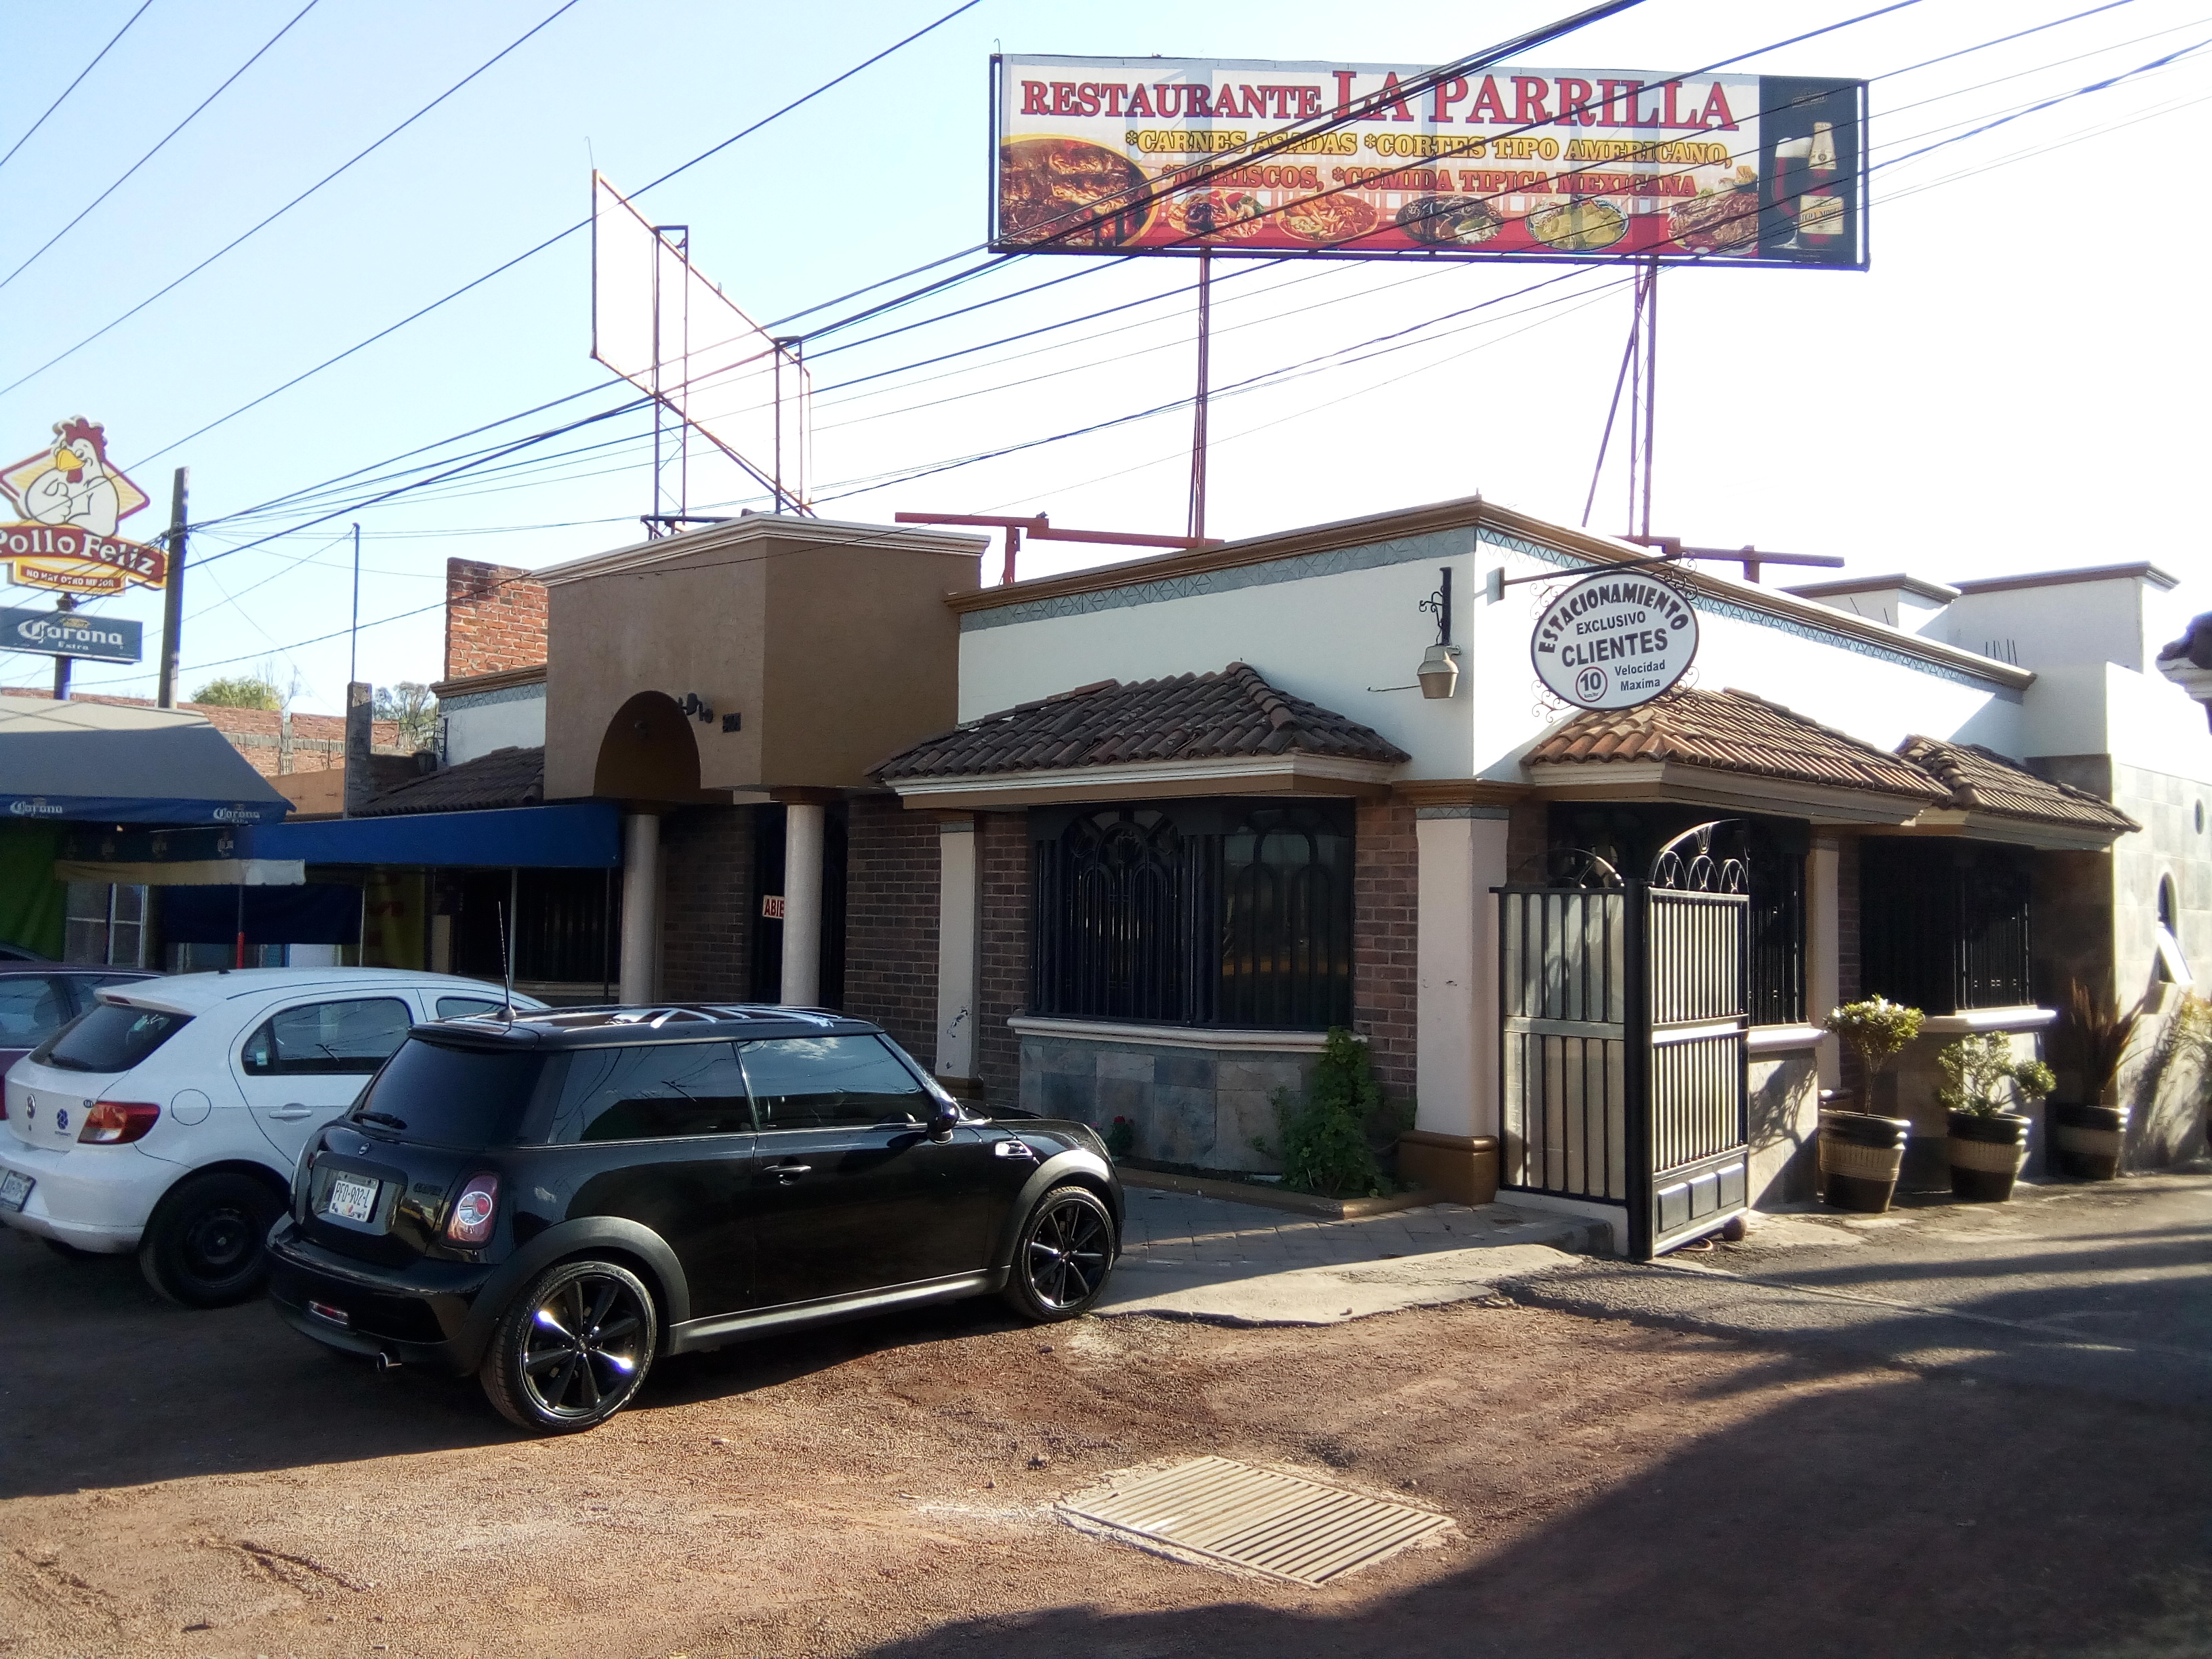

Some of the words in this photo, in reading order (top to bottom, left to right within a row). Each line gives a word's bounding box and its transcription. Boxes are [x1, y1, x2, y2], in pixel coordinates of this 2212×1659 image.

[1021, 80, 1322, 119] RESTAURANTE
[1332, 70, 1414, 121] LA
[1429, 73, 1739, 131] PARRILLA
[1252, 131, 1357, 156] ASADAS
[1493, 138, 1559, 161] TIPO
[1564, 140, 1732, 168] AMERICANO,
[1459, 170, 1552, 194] TIPICA
[1556, 173, 1699, 197] MEXICANA
[81, 533, 156, 575] Feliz
[26, 569, 39, 578] NO
[1538, 583, 1689, 653] ESTACIONAMIENTO
[1576, 611, 1646, 635] EXCLUSIVO
[18, 619, 124, 644] Corona
[58, 640, 89, 651] Extra
[1561, 628, 1668, 667] CLIENTES
[1614, 659, 1666, 676] Velocidad
[1580, 672, 1601, 691] 10
[1620, 678, 1660, 691] Maxima
[9, 800, 62, 815] Corona
[213, 806, 260, 820] Corona
[764, 898, 785, 918] ABIE
